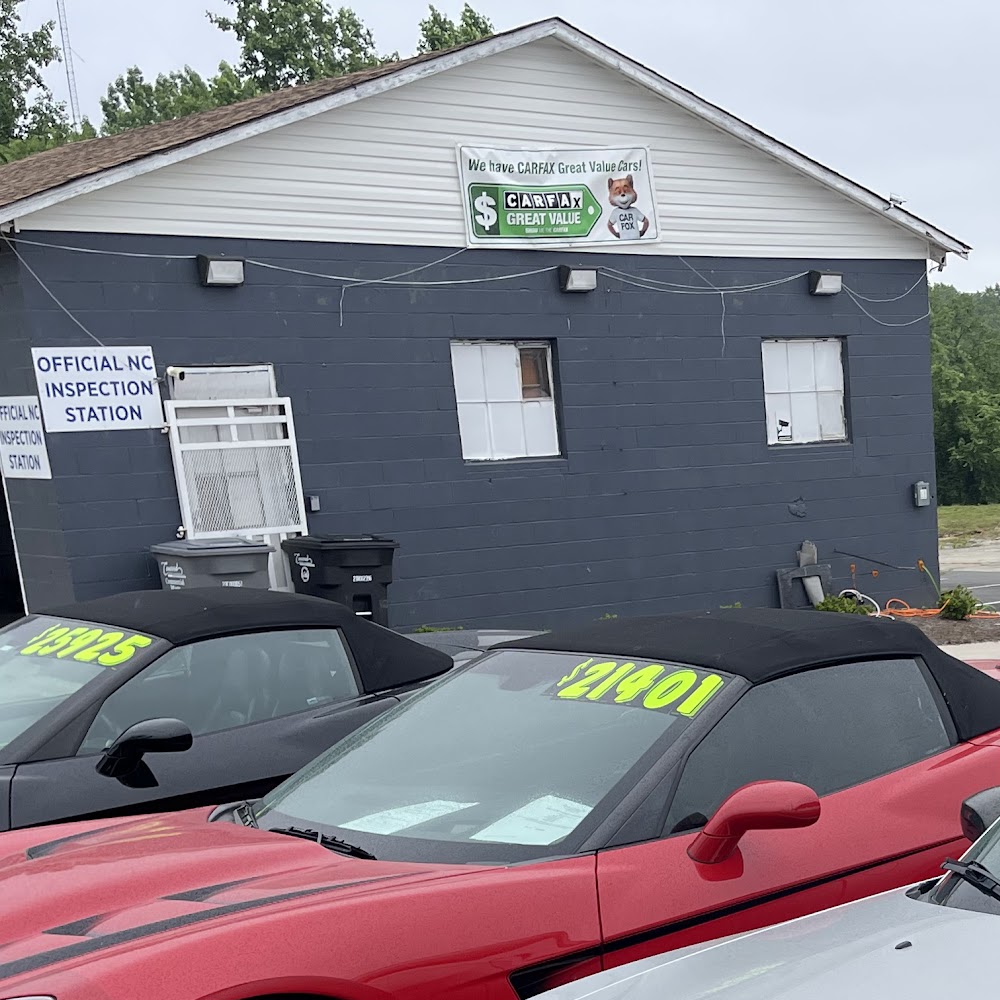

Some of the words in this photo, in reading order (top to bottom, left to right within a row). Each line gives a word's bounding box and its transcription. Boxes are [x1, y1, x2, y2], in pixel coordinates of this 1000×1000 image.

[469, 158, 486, 171] We
[489, 160, 515, 173] have
[518, 161, 555, 174] CARFAX
[558, 161, 586, 174] Great
[589, 160, 617, 172] Value
[618, 159, 642, 171] Cars!
[505, 192, 582, 209] CARFAX
[507, 213, 546, 225] GREAT
[549, 212, 581, 224] VALUE
[619, 213, 634, 222] CAR
[621, 222, 635, 230] FOX
[37, 356, 124, 372] OFFICIAL
[127, 355, 153, 371] NC
[45, 380, 154, 398] INSPECTION
[0, 405, 28, 420] FFICIAL
[28, 404, 40, 420] NC
[65, 405, 143, 422] STATION
[0, 430, 42, 446] INSPECTION
[9, 454, 41, 470] STATION
